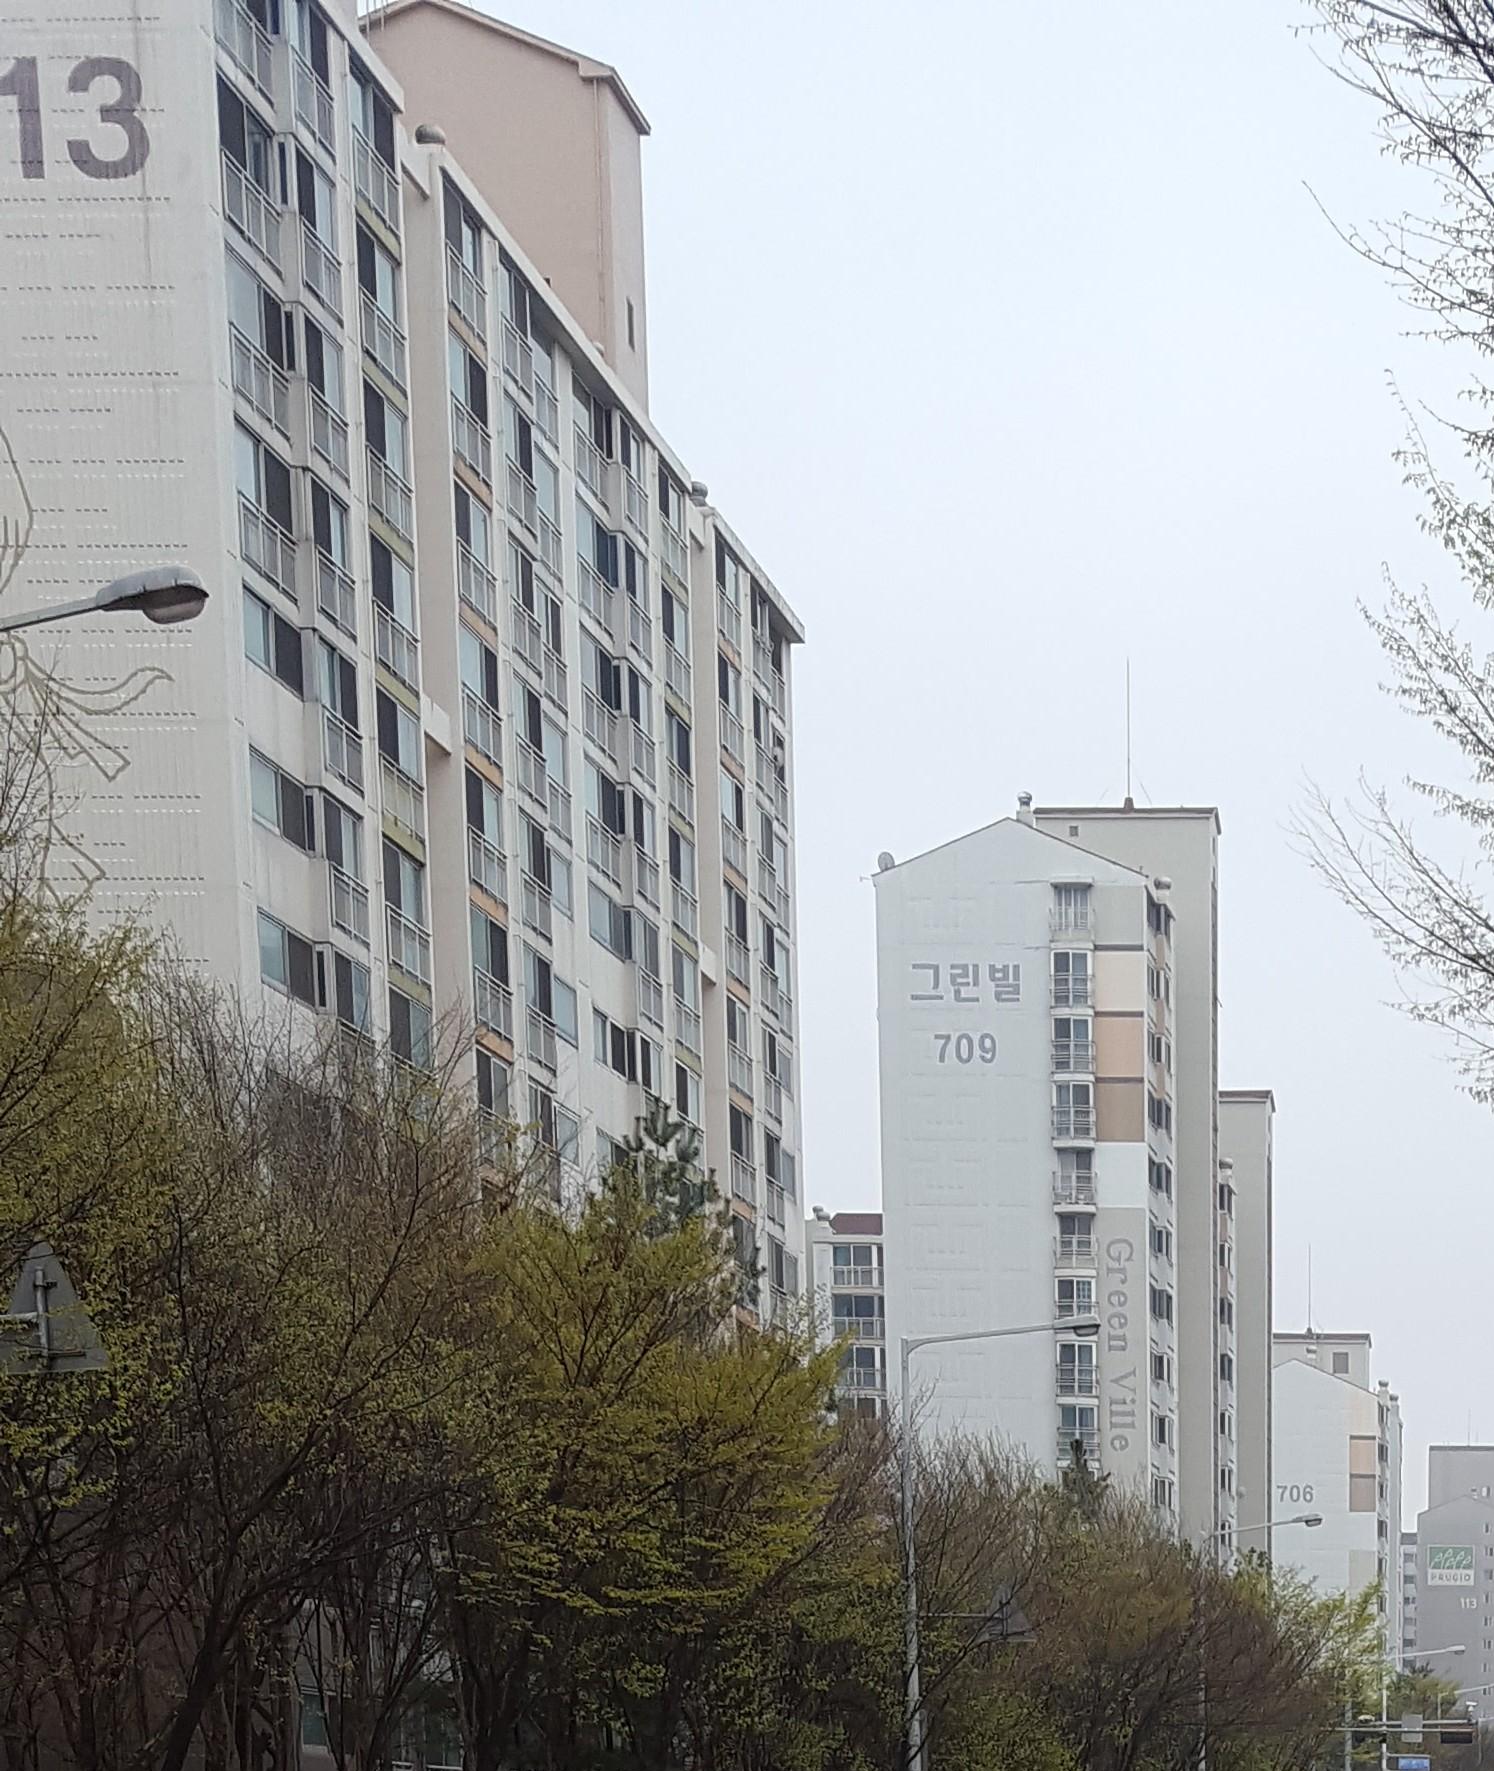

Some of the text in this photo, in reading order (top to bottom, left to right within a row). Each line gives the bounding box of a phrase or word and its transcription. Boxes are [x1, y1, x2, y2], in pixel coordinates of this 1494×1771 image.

[909, 961, 1022, 1004] 그린빌
[933, 1031, 998, 1065] 709
[1104, 1236, 1140, 1453] Green Ville
[1276, 1483, 1315, 1504] 706
[1460, 1598, 1478, 1609] 113
